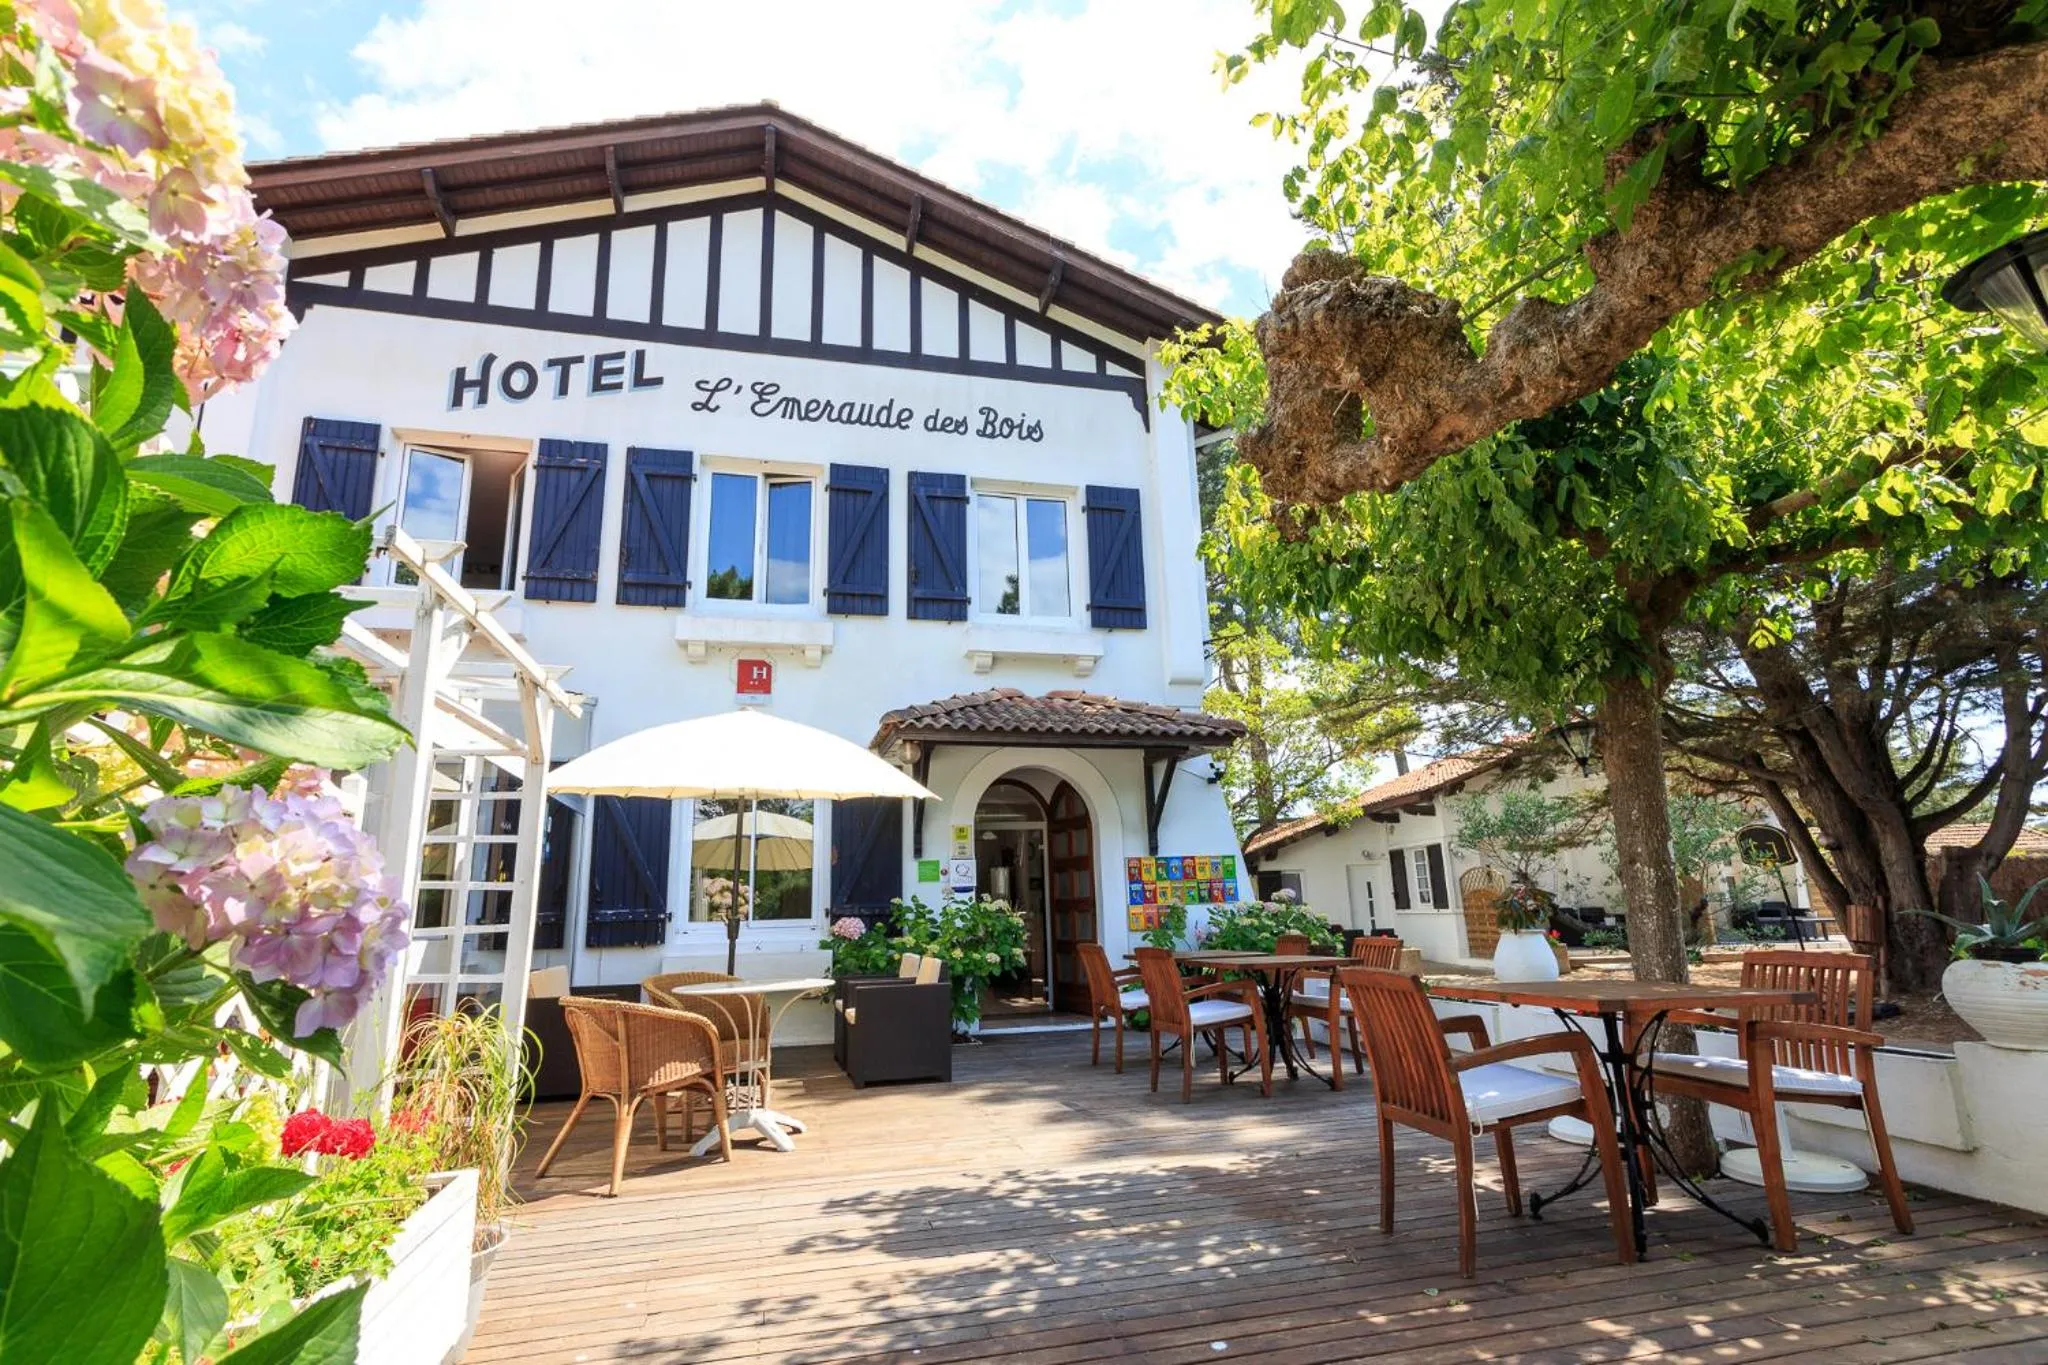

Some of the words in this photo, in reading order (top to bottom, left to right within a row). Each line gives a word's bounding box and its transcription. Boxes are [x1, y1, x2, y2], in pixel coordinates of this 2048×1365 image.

[448, 349, 664, 411] HOTEL
[923, 408, 969, 436] des
[976, 406, 1045, 443] Bois
[753, 666, 767, 679] H
